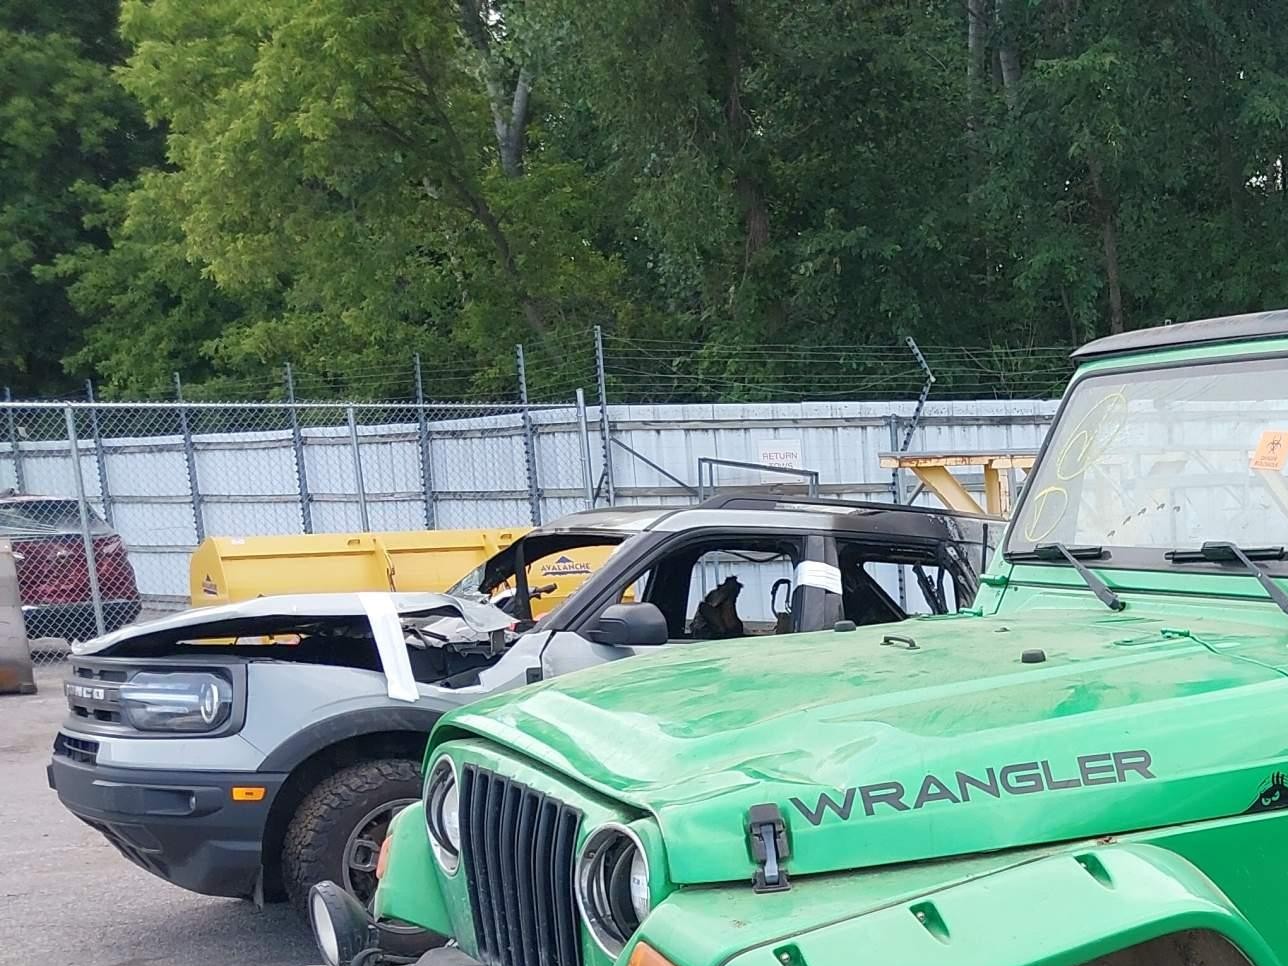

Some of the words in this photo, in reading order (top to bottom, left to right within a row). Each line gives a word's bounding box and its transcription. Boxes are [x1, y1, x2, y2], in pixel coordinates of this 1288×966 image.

[762, 452, 798, 460] RETURN
[541, 562, 590, 571] AVALANCHE
[789, 749, 1156, 826] WRANGLER
